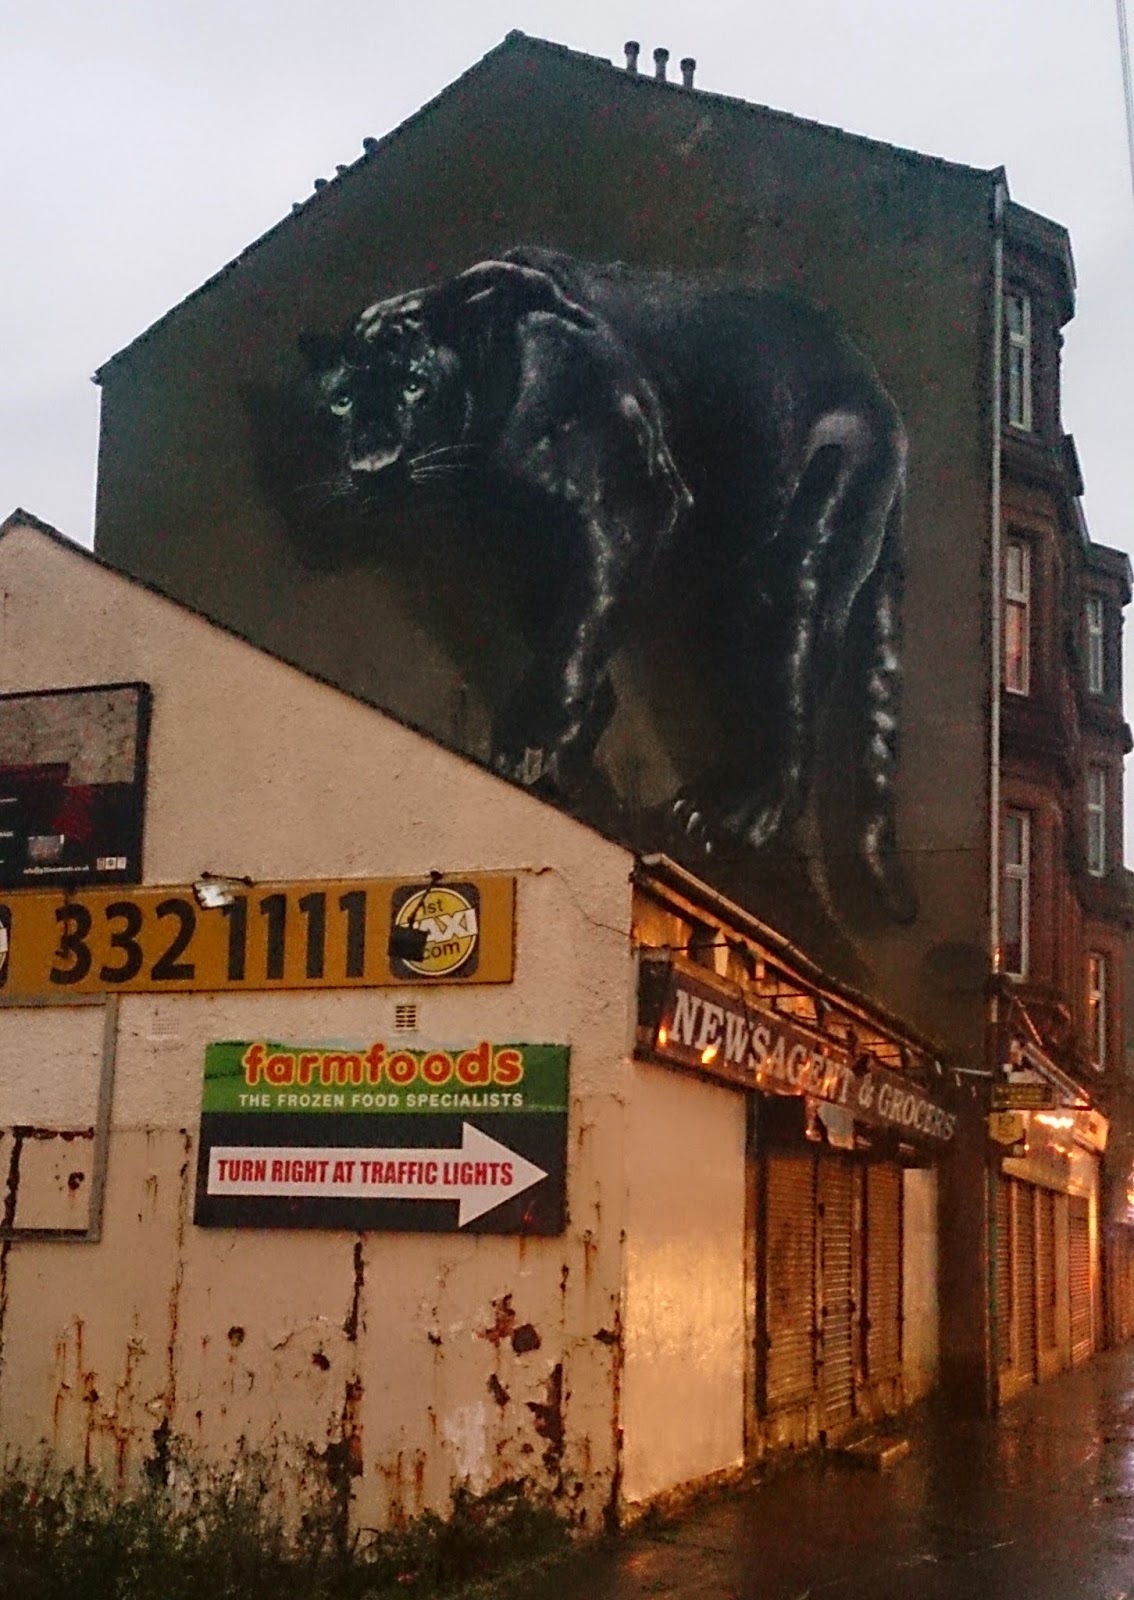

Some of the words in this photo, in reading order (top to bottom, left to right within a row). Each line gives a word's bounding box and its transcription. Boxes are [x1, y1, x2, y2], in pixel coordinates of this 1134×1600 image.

[50, 898, 196, 985] 332
[223, 891, 366, 981] 1111
[400, 908, 478, 943] AXI
[242, 1041, 525, 1087] farmfoods
[669, 988, 853, 1104] NEWSAGENT
[878, 1083, 956, 1140] GROCERS
[239, 1094, 271, 1107] THE
[277, 1094, 345, 1107] FROZEN
[352, 1094, 399, 1107] FOOD
[406, 1093, 524, 1107] SPECIALISTS
[217, 1159, 266, 1182] TURN
[271, 1160, 328, 1183] RIGHT
[332, 1161, 356, 1183] AT
[360, 1161, 438, 1185] TRAFFIC
[443, 1162, 514, 1186] LIGHTS
